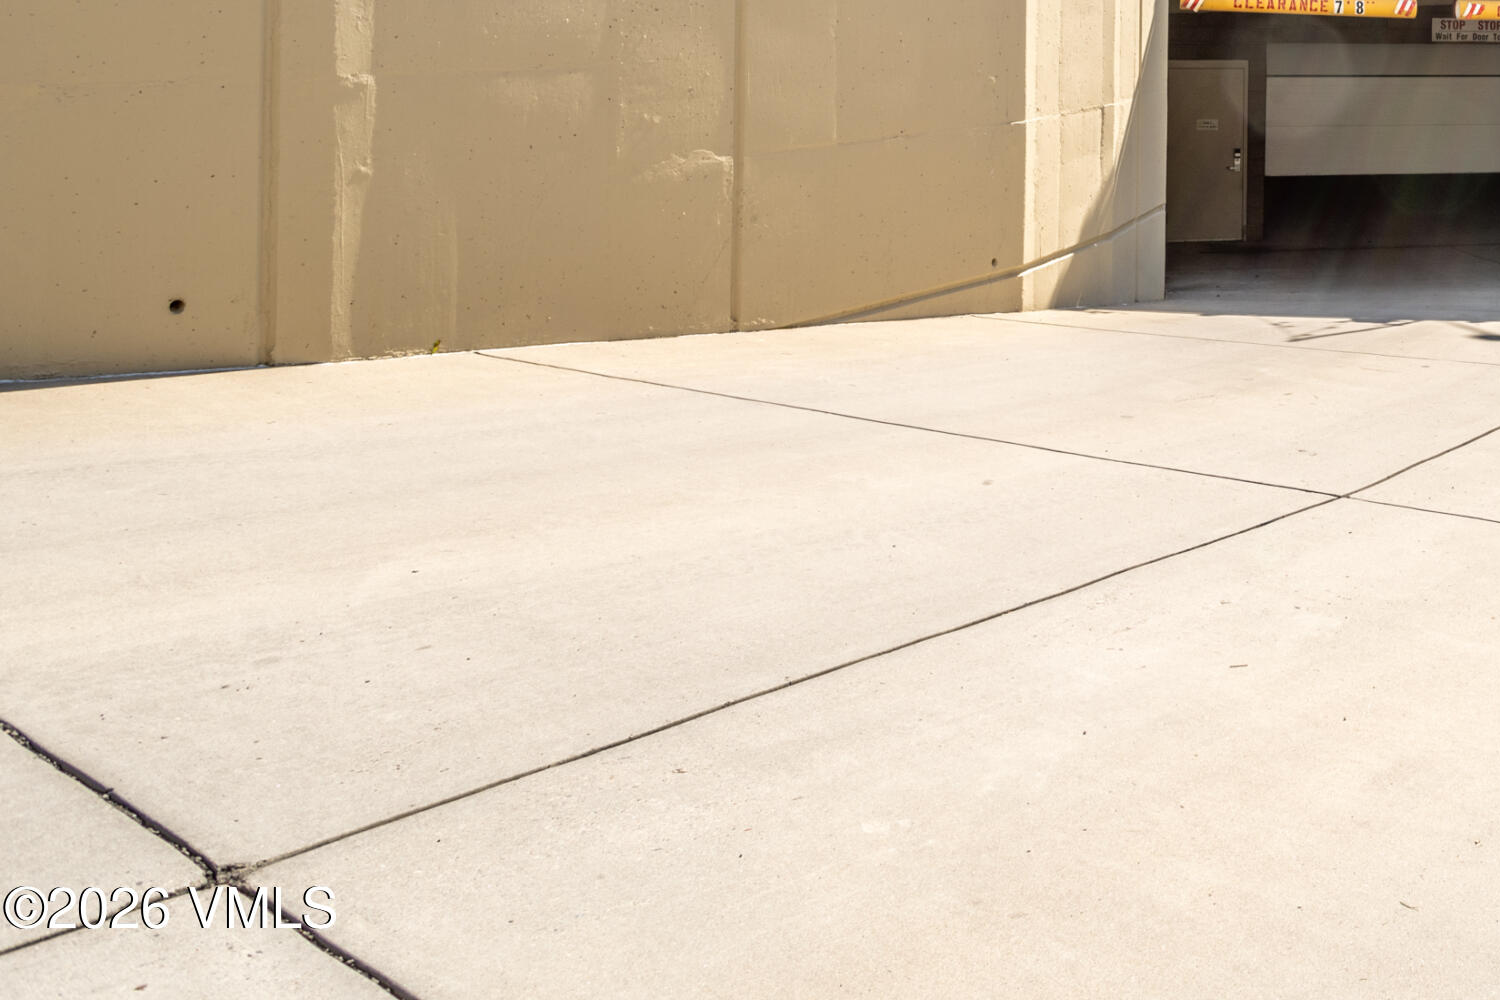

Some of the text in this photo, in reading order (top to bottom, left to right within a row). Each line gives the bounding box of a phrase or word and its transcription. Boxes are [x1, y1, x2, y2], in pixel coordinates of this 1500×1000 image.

[1440, 19, 1466, 30] STOP
[1435, 32, 1452, 40] Wait
[1472, 33, 1489, 41] Door
